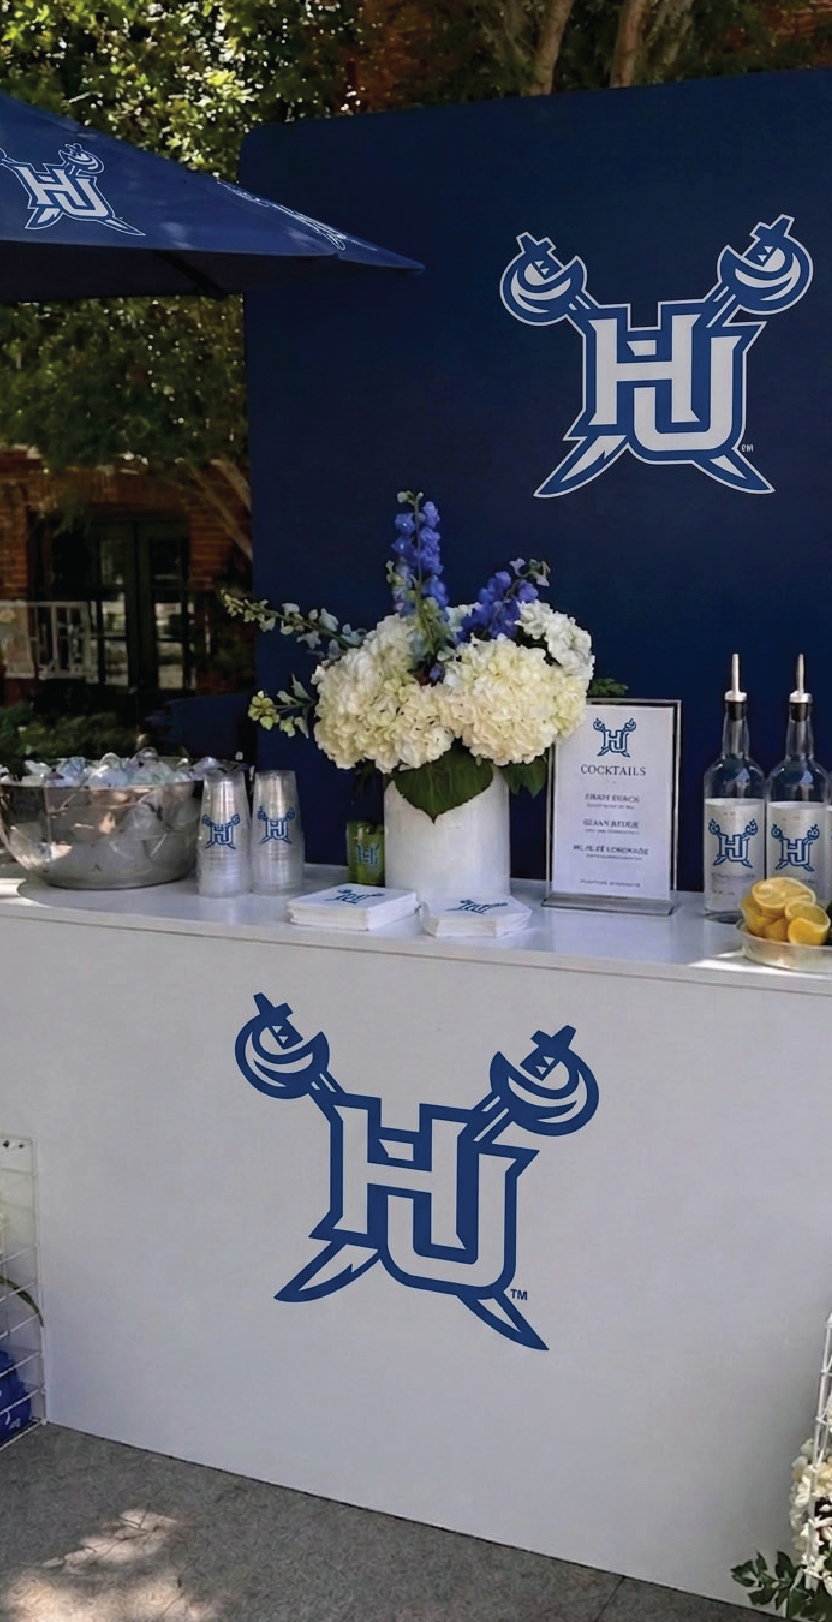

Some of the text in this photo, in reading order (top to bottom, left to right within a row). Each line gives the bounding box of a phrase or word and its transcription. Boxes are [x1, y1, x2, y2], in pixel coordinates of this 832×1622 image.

[13, 163, 111, 218] HU
[584, 309, 746, 455] HU
[604, 730, 630, 753] HU
[580, 763, 647, 777] COCKTAILS
[719, 833, 750, 863] HU
[782, 839, 813, 866] HU
[328, 1098, 522, 1291] HU
[510, 1288, 528, 1301] TM
